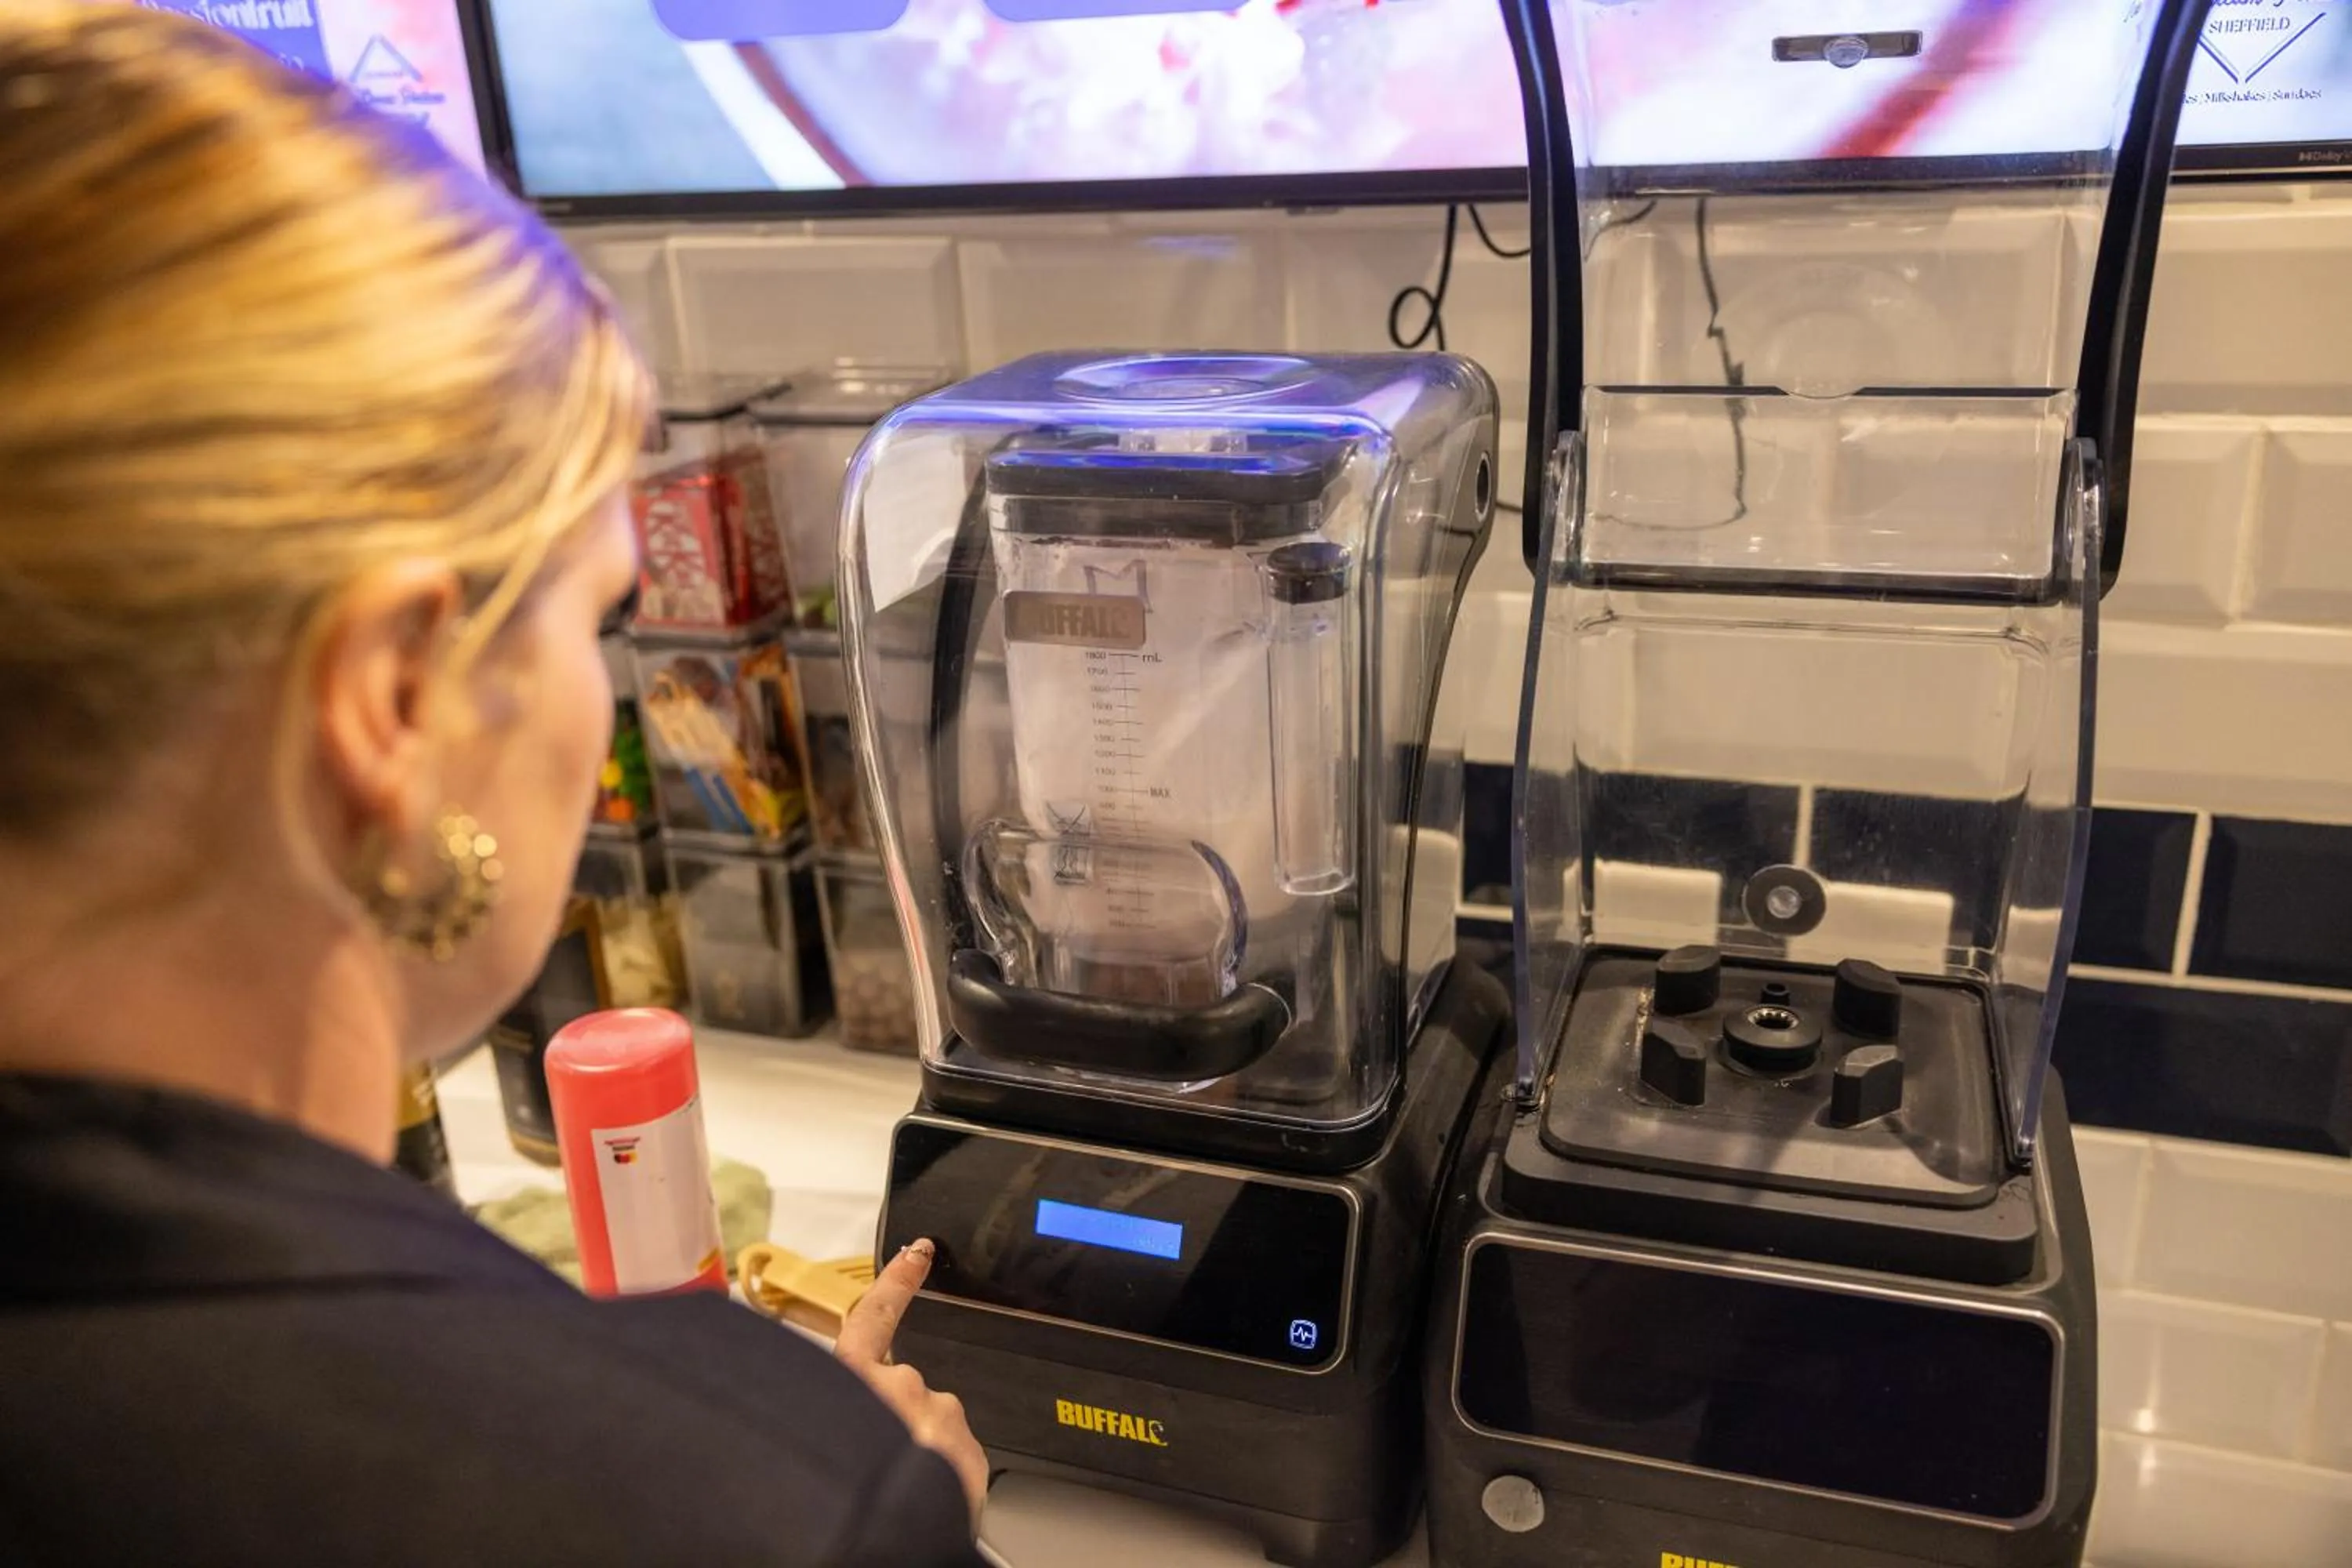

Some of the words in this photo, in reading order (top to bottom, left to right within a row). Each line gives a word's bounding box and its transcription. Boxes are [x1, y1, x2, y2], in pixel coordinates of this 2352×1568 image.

[2209, 16, 2291, 34] SHEFFIELD
[1142, 652, 1163, 662] mL
[1056, 1399, 1168, 1446] BUFFALO
